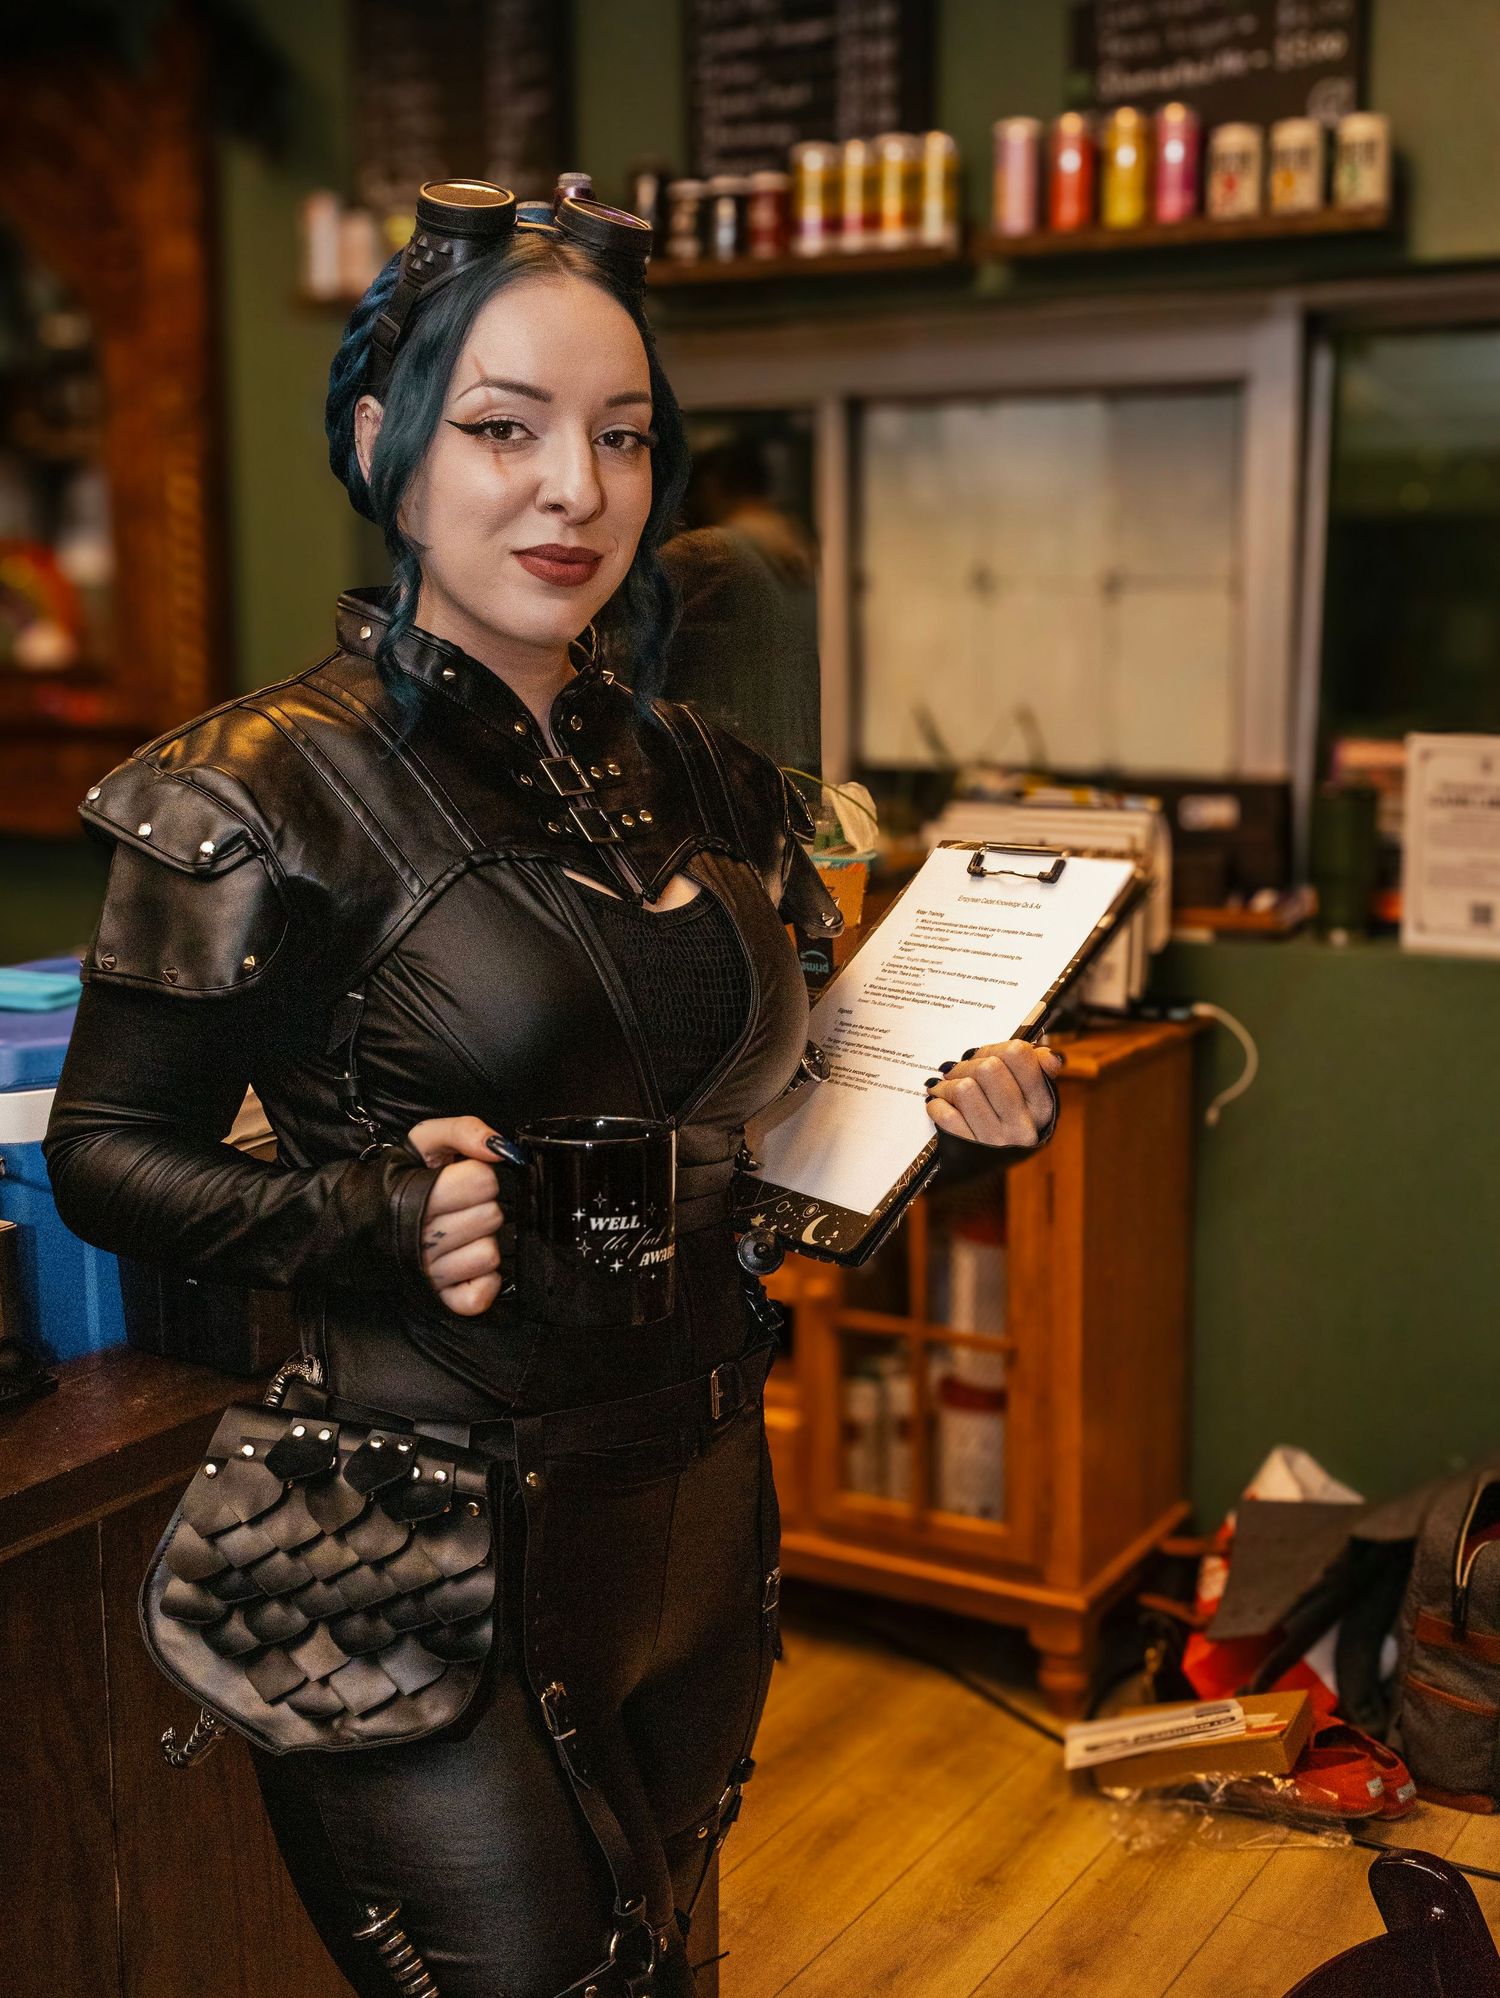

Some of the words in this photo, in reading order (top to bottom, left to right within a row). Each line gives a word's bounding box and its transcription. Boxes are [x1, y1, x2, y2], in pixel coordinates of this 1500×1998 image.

[995, 900, 1021, 908] Knowledge
[589, 1215, 641, 1231] WELL
[602, 1233, 629, 1250] the
[627, 1226, 667, 1260] fuck
